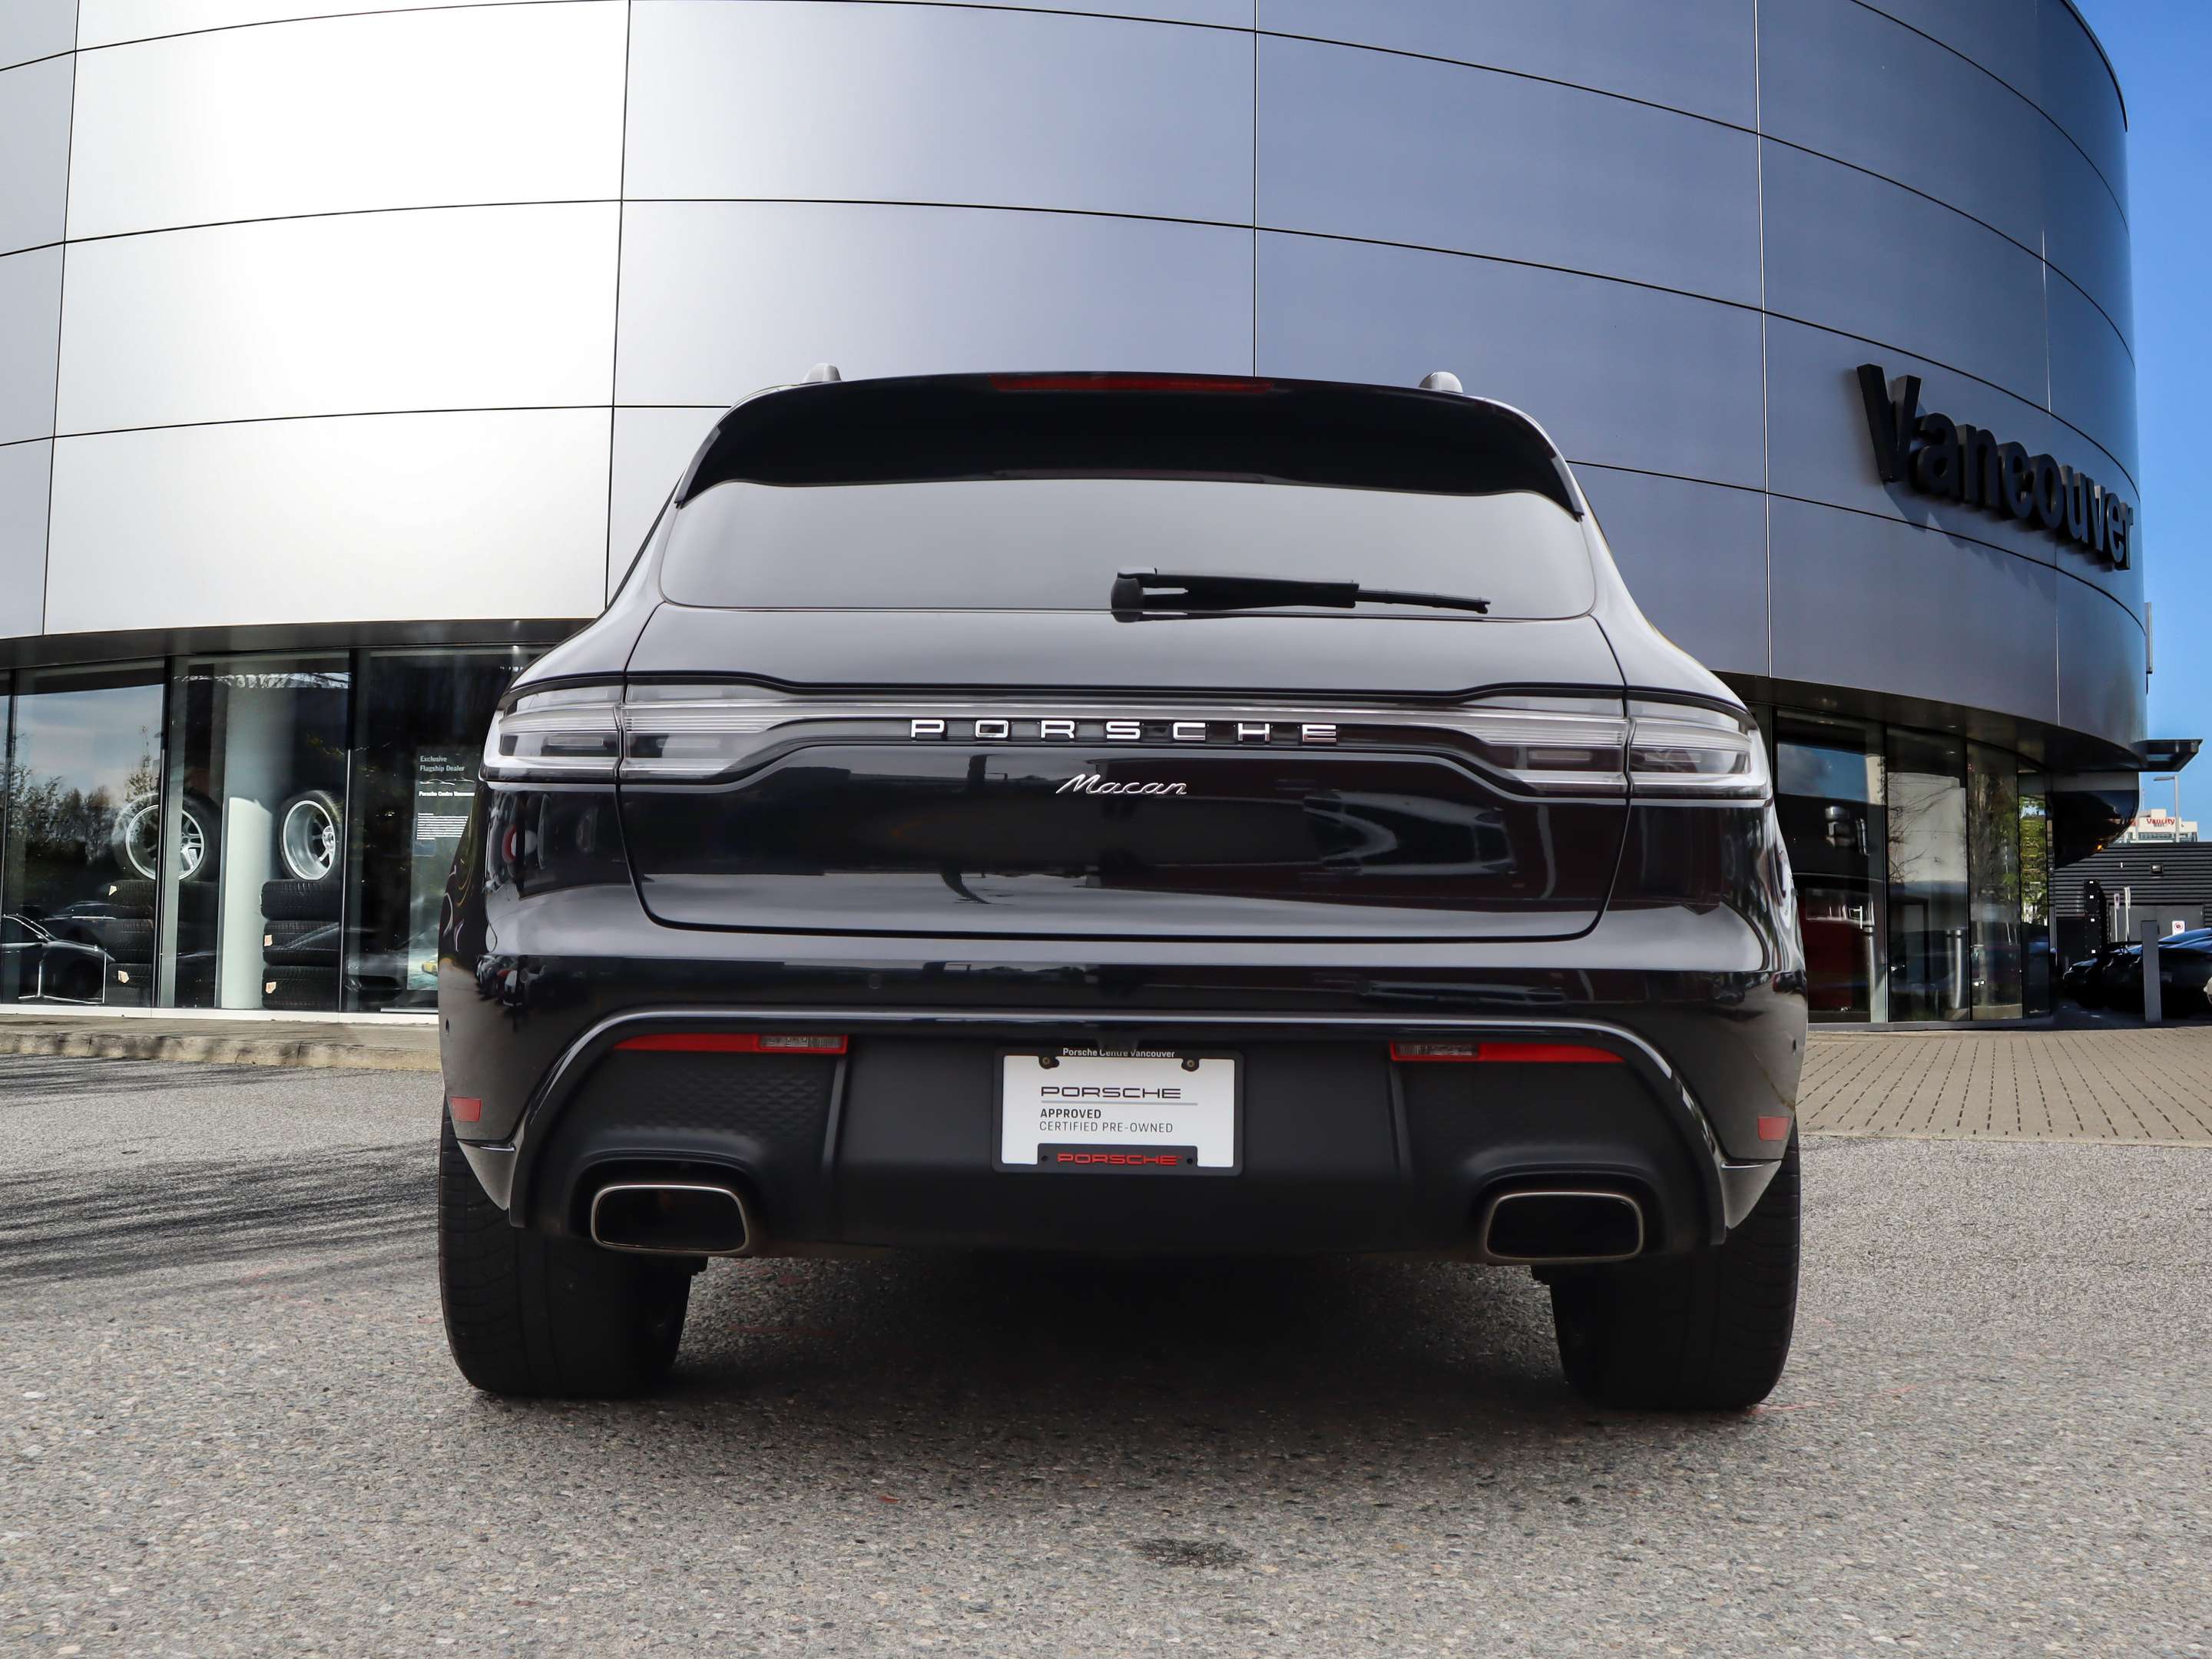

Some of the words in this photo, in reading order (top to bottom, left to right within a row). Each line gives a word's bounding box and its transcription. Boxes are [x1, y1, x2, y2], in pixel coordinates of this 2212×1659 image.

[1856, 363, 2134, 571] Vancouver
[911, 719, 1336, 743] PORSCHE
[1055, 773, 1187, 794] Macan
[1063, 1048, 1098, 1057] Porsche
[1131, 1049, 1175, 1058] Vancouver
[1041, 1087, 1181, 1098] PORSCHE
[1040, 1108, 1101, 1119] APPROVED
[1039, 1121, 1098, 1131] CERTIFIED
[1102, 1123, 1174, 1132] PRE-OWNED
[1057, 1153, 1178, 1165] PORSCHE
